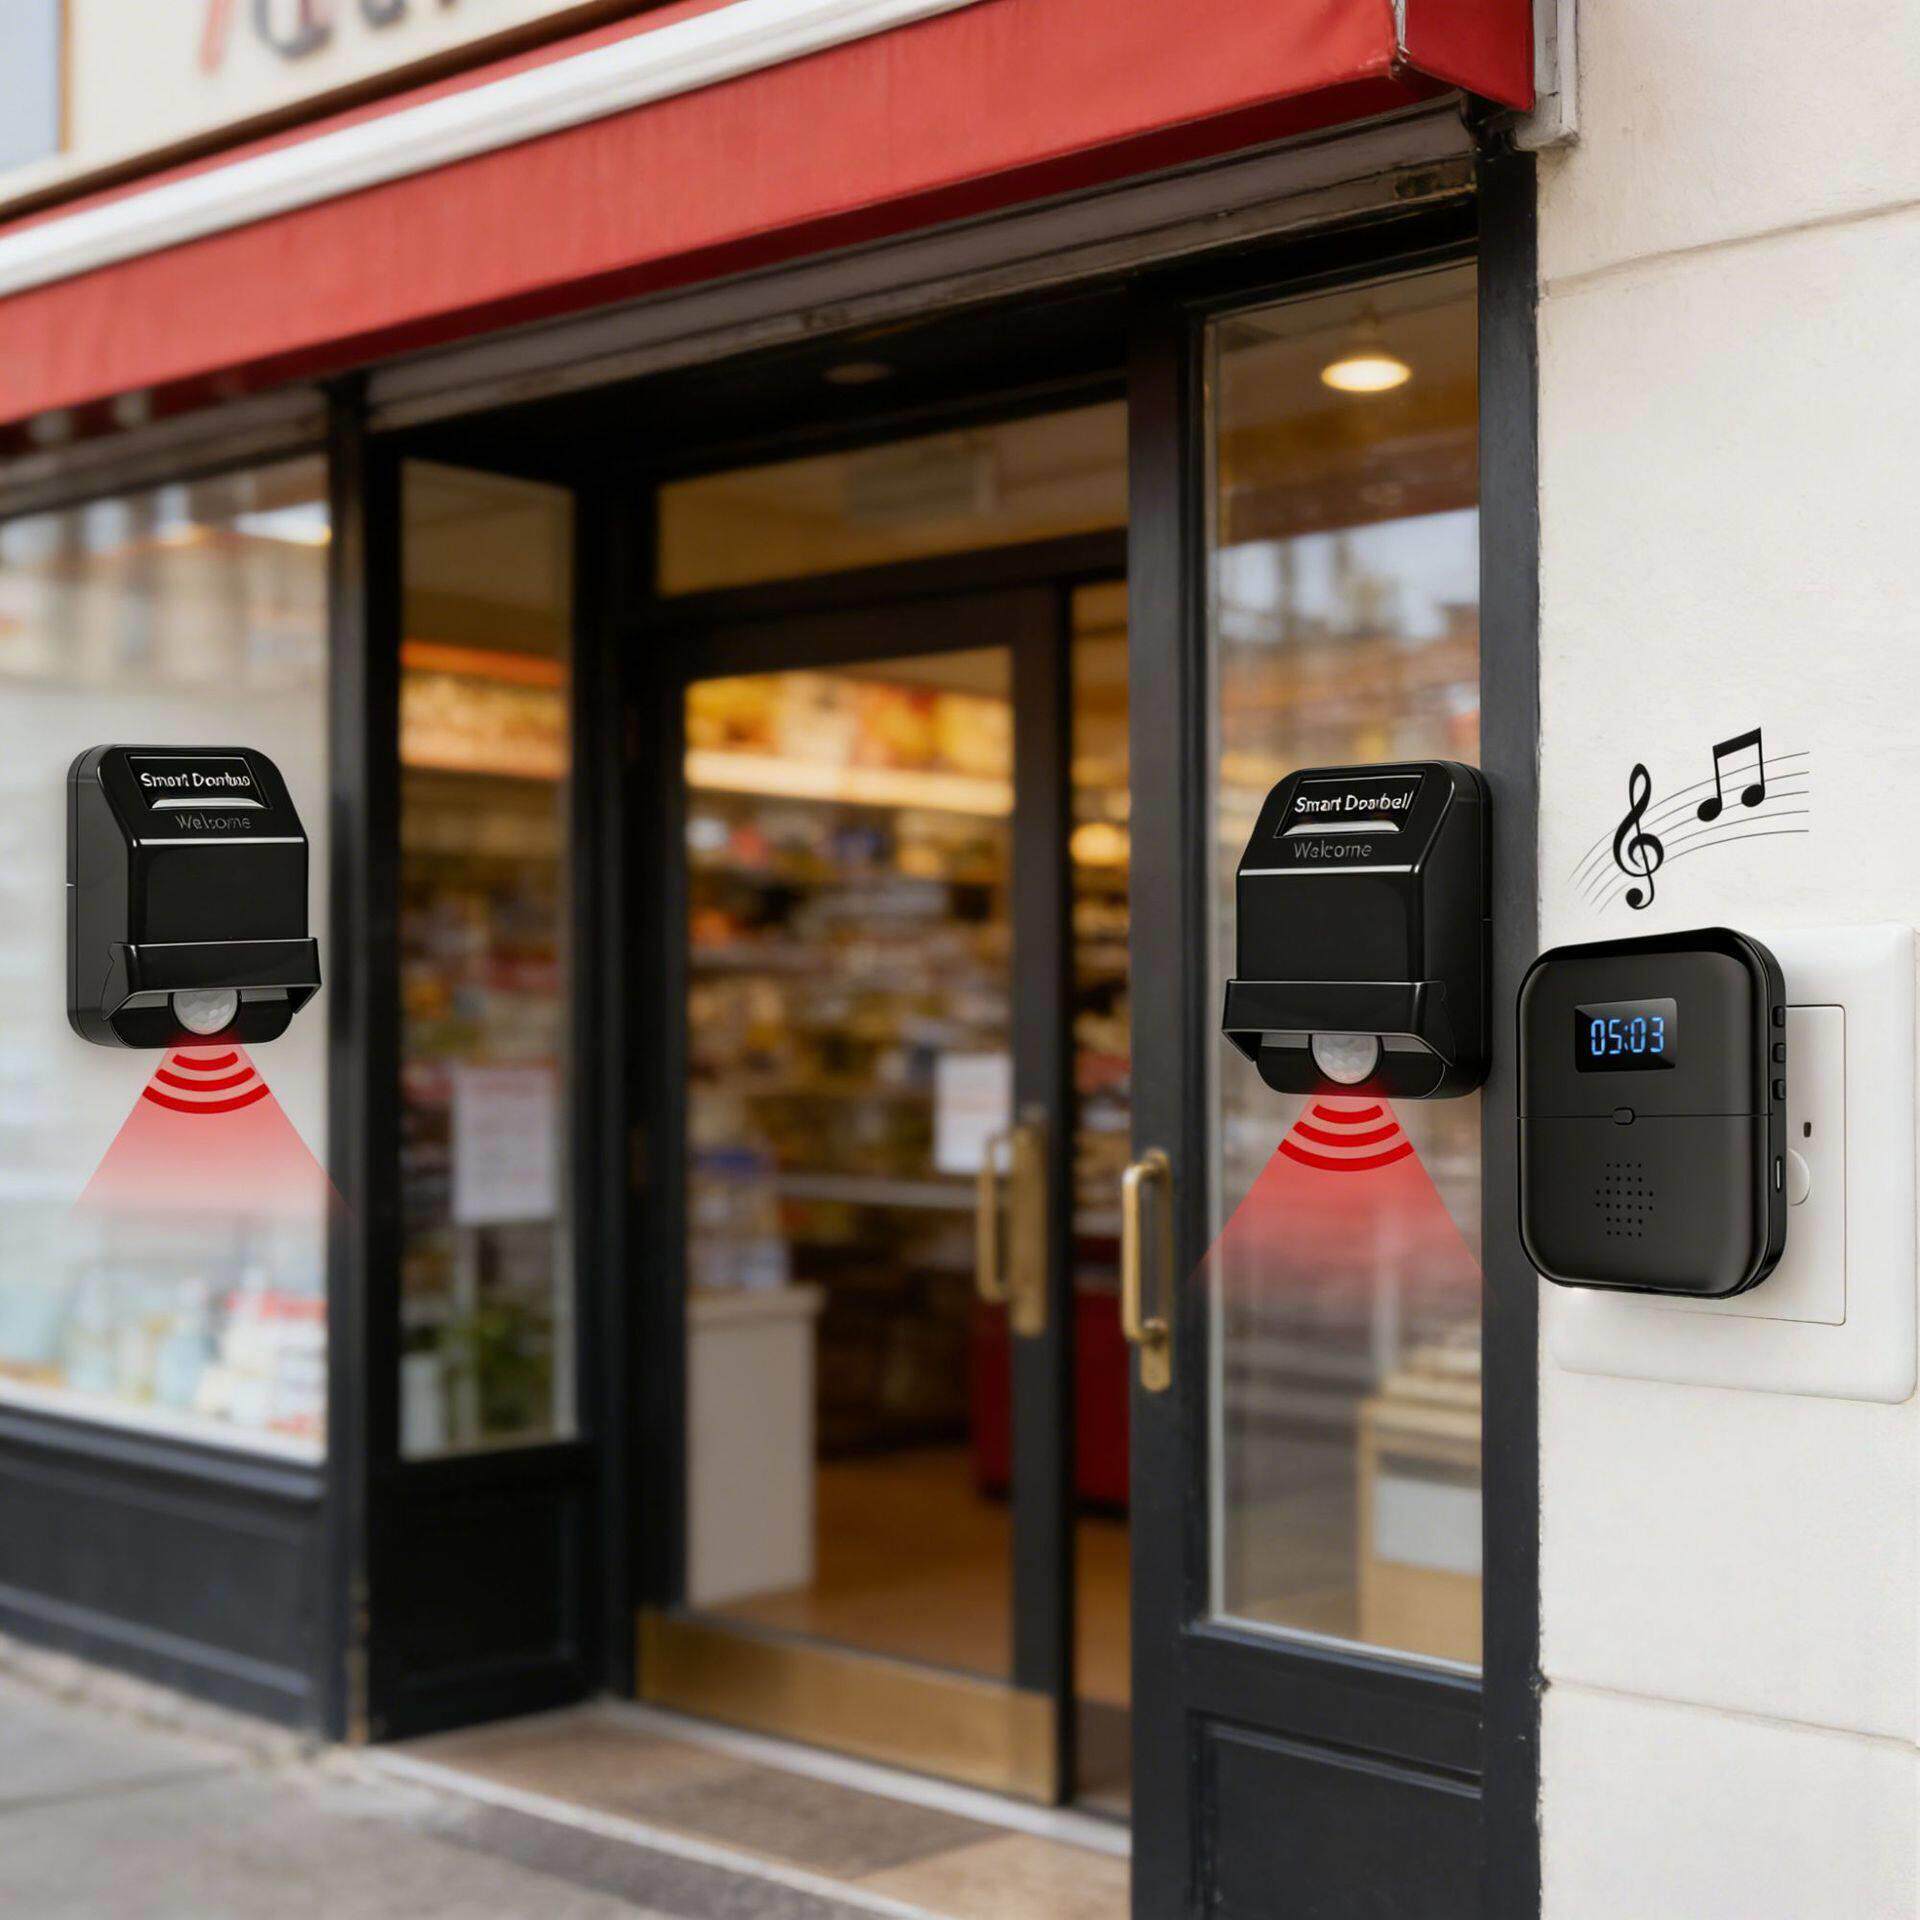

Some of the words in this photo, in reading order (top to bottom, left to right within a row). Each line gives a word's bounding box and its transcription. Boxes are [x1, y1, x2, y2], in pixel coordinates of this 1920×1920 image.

[1294, 796, 1341, 813] Smart
[175, 813, 251, 830] Welcome
[1293, 841, 1373, 858] Welcome
[1591, 1016, 1664, 1055] 05:03
